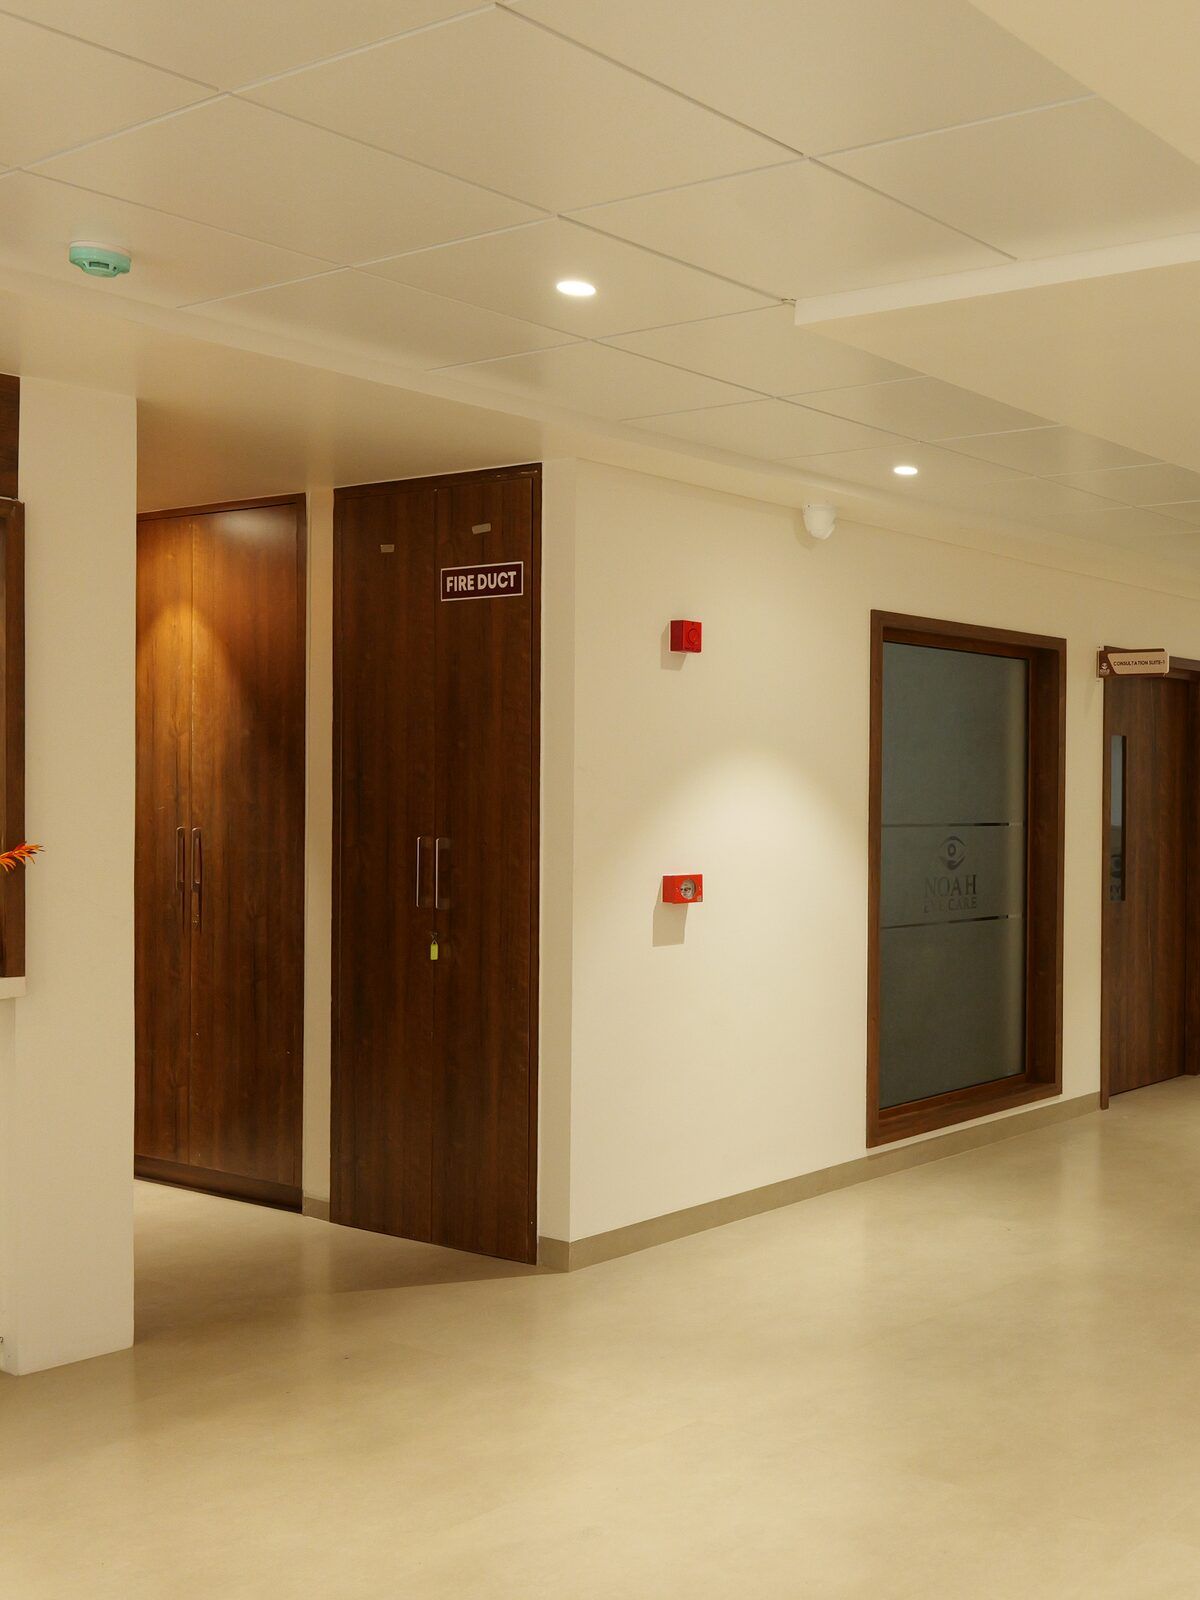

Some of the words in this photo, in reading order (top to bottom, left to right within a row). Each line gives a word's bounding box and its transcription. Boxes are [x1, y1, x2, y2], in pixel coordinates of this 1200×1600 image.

[446, 574, 475, 592] FIRE
[477, 571, 517, 590] DUCT
[923, 874, 976, 897] NOAH
